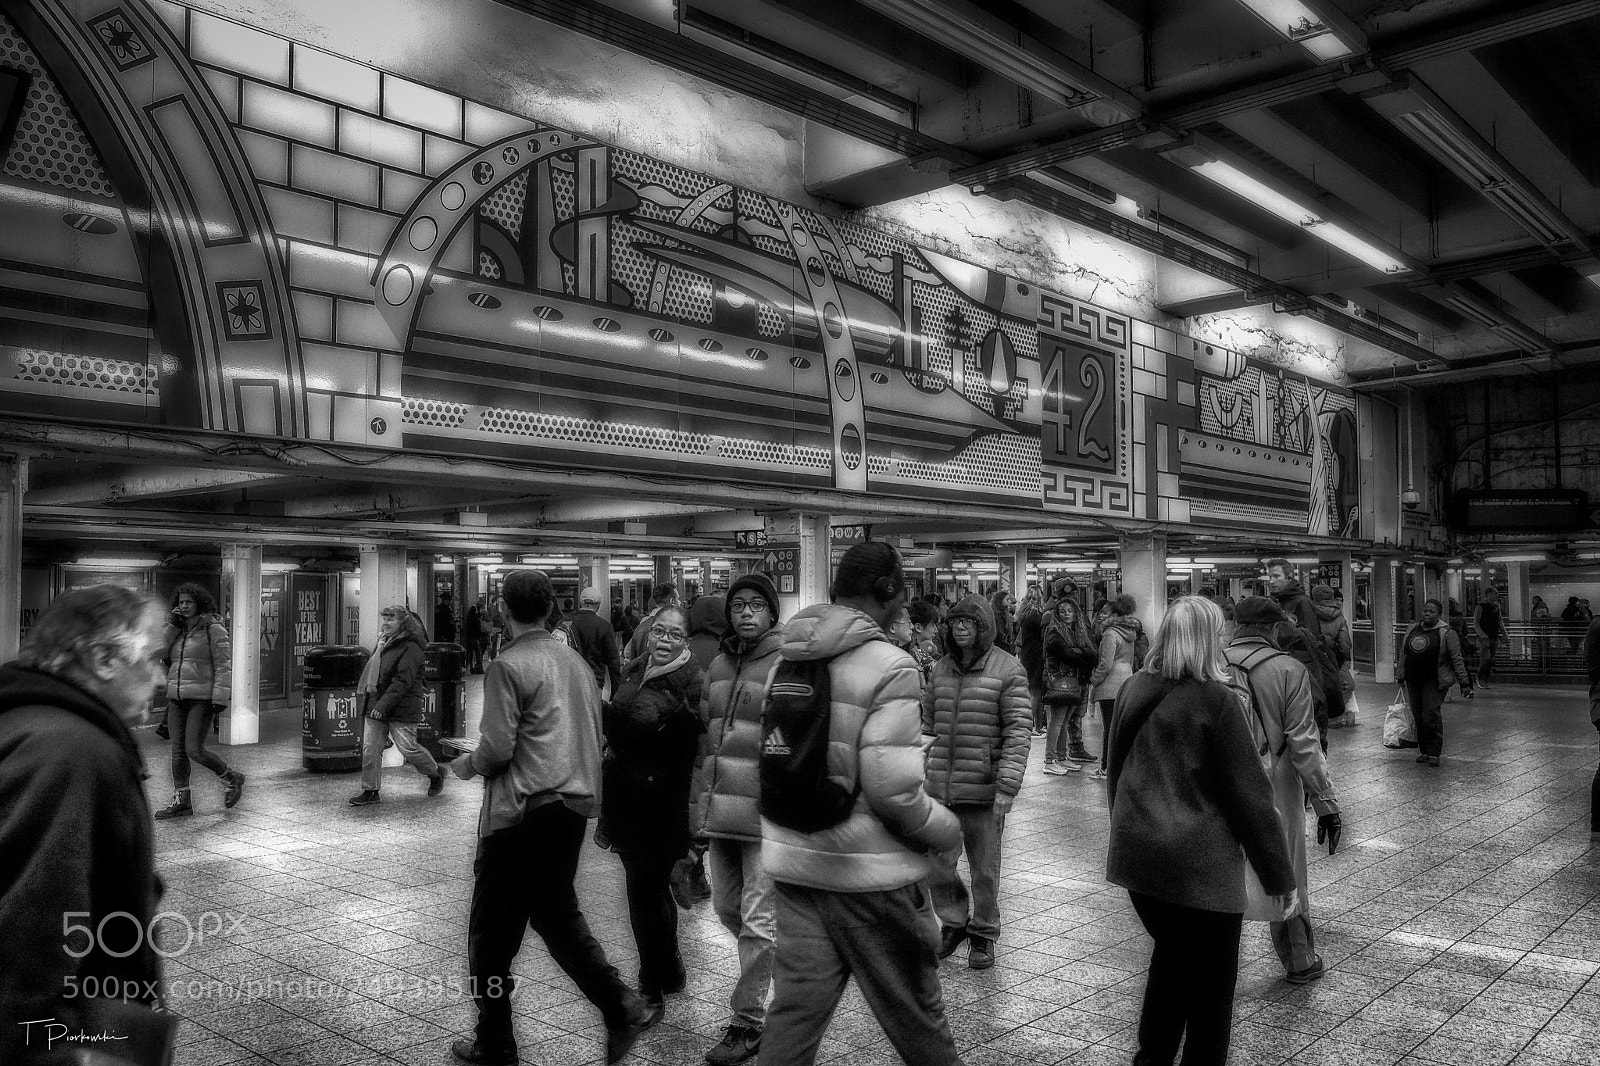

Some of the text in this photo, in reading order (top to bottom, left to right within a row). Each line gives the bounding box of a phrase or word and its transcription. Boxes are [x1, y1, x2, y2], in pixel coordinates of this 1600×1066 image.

[1039, 348, 1111, 462] 42
[307, 612, 316, 622] THE
[294, 622, 322, 644] YEAR!
